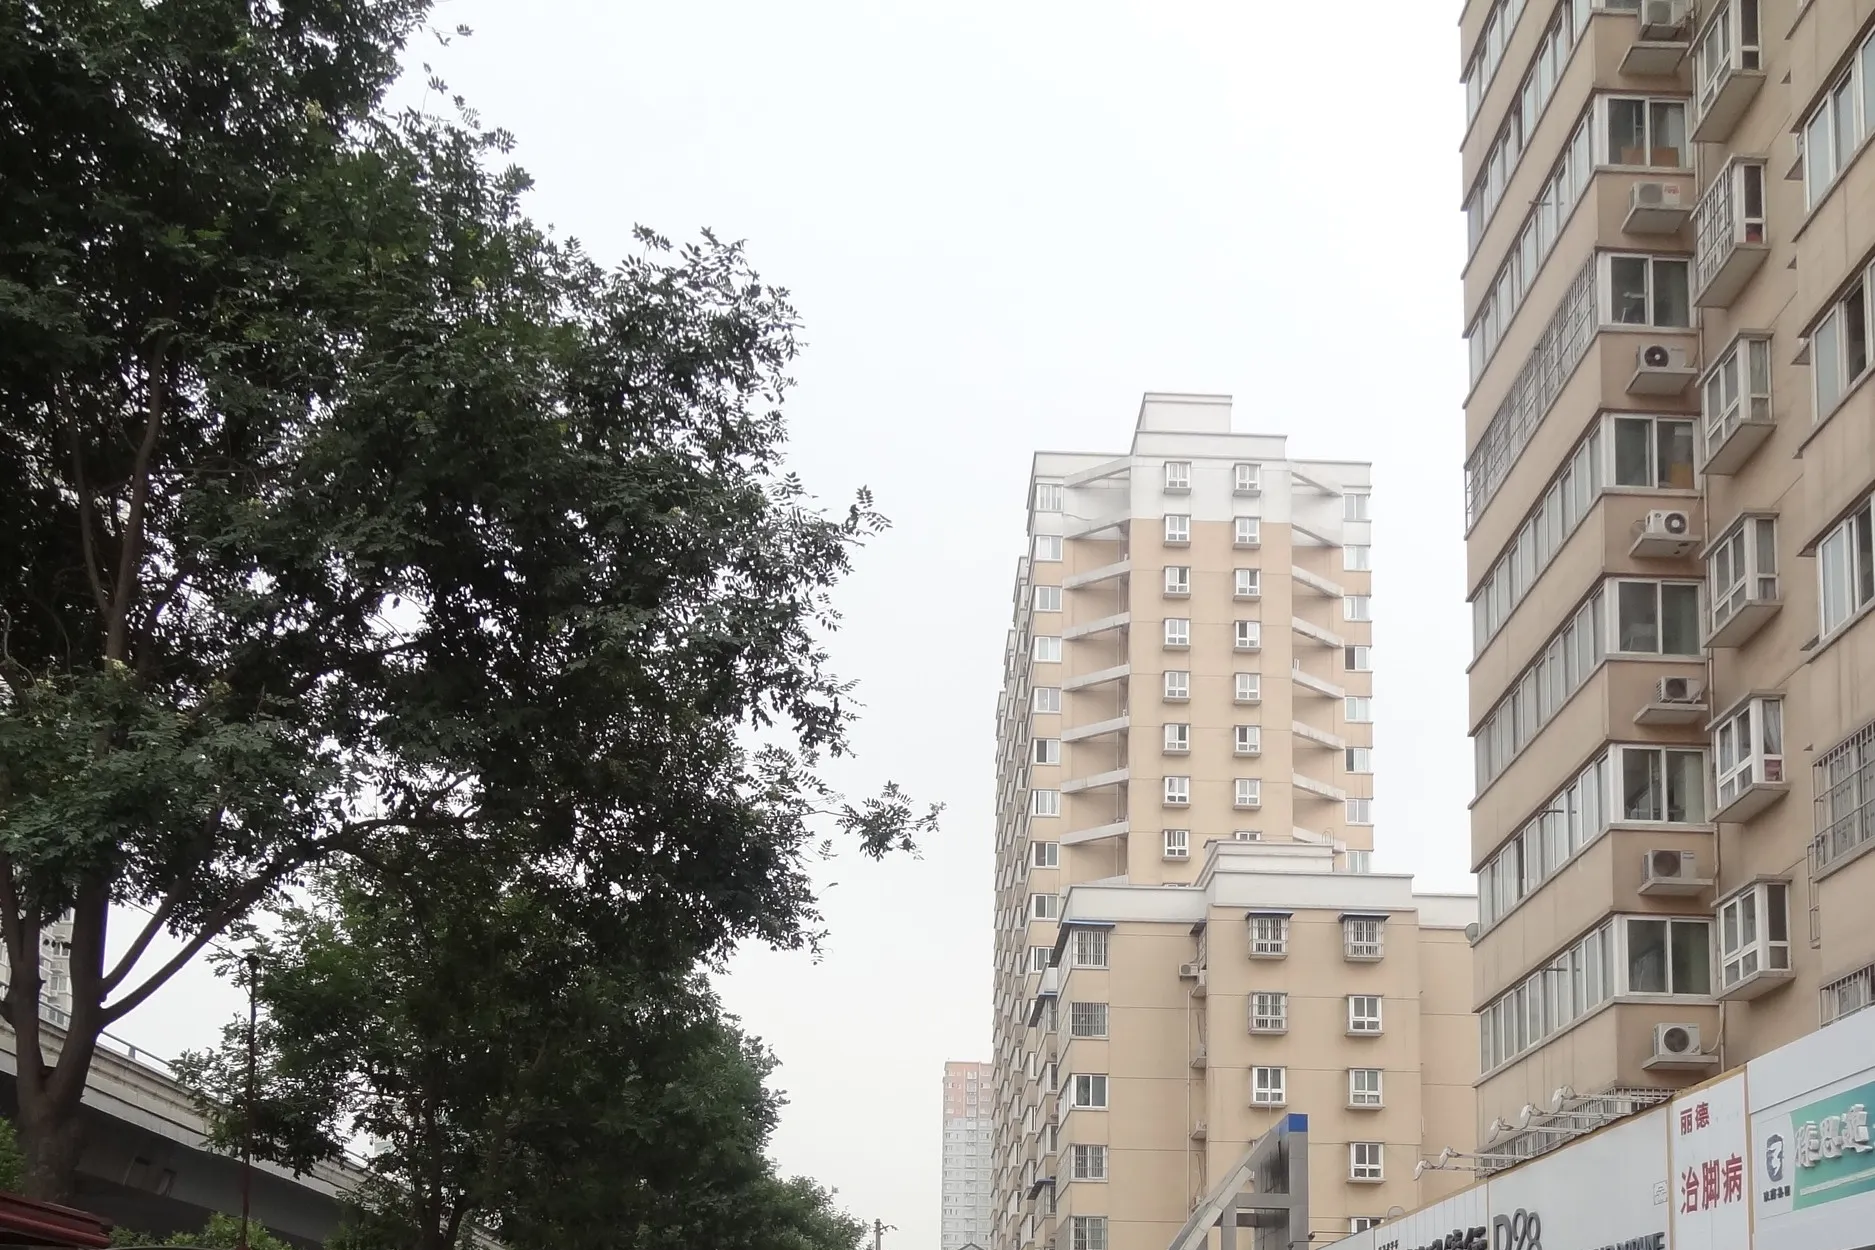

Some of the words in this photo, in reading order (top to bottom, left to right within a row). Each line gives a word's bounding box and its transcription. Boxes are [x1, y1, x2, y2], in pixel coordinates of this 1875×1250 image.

[1680, 1102, 1709, 1135] 丽德
[1680, 1153, 1742, 1214] 治脚病
